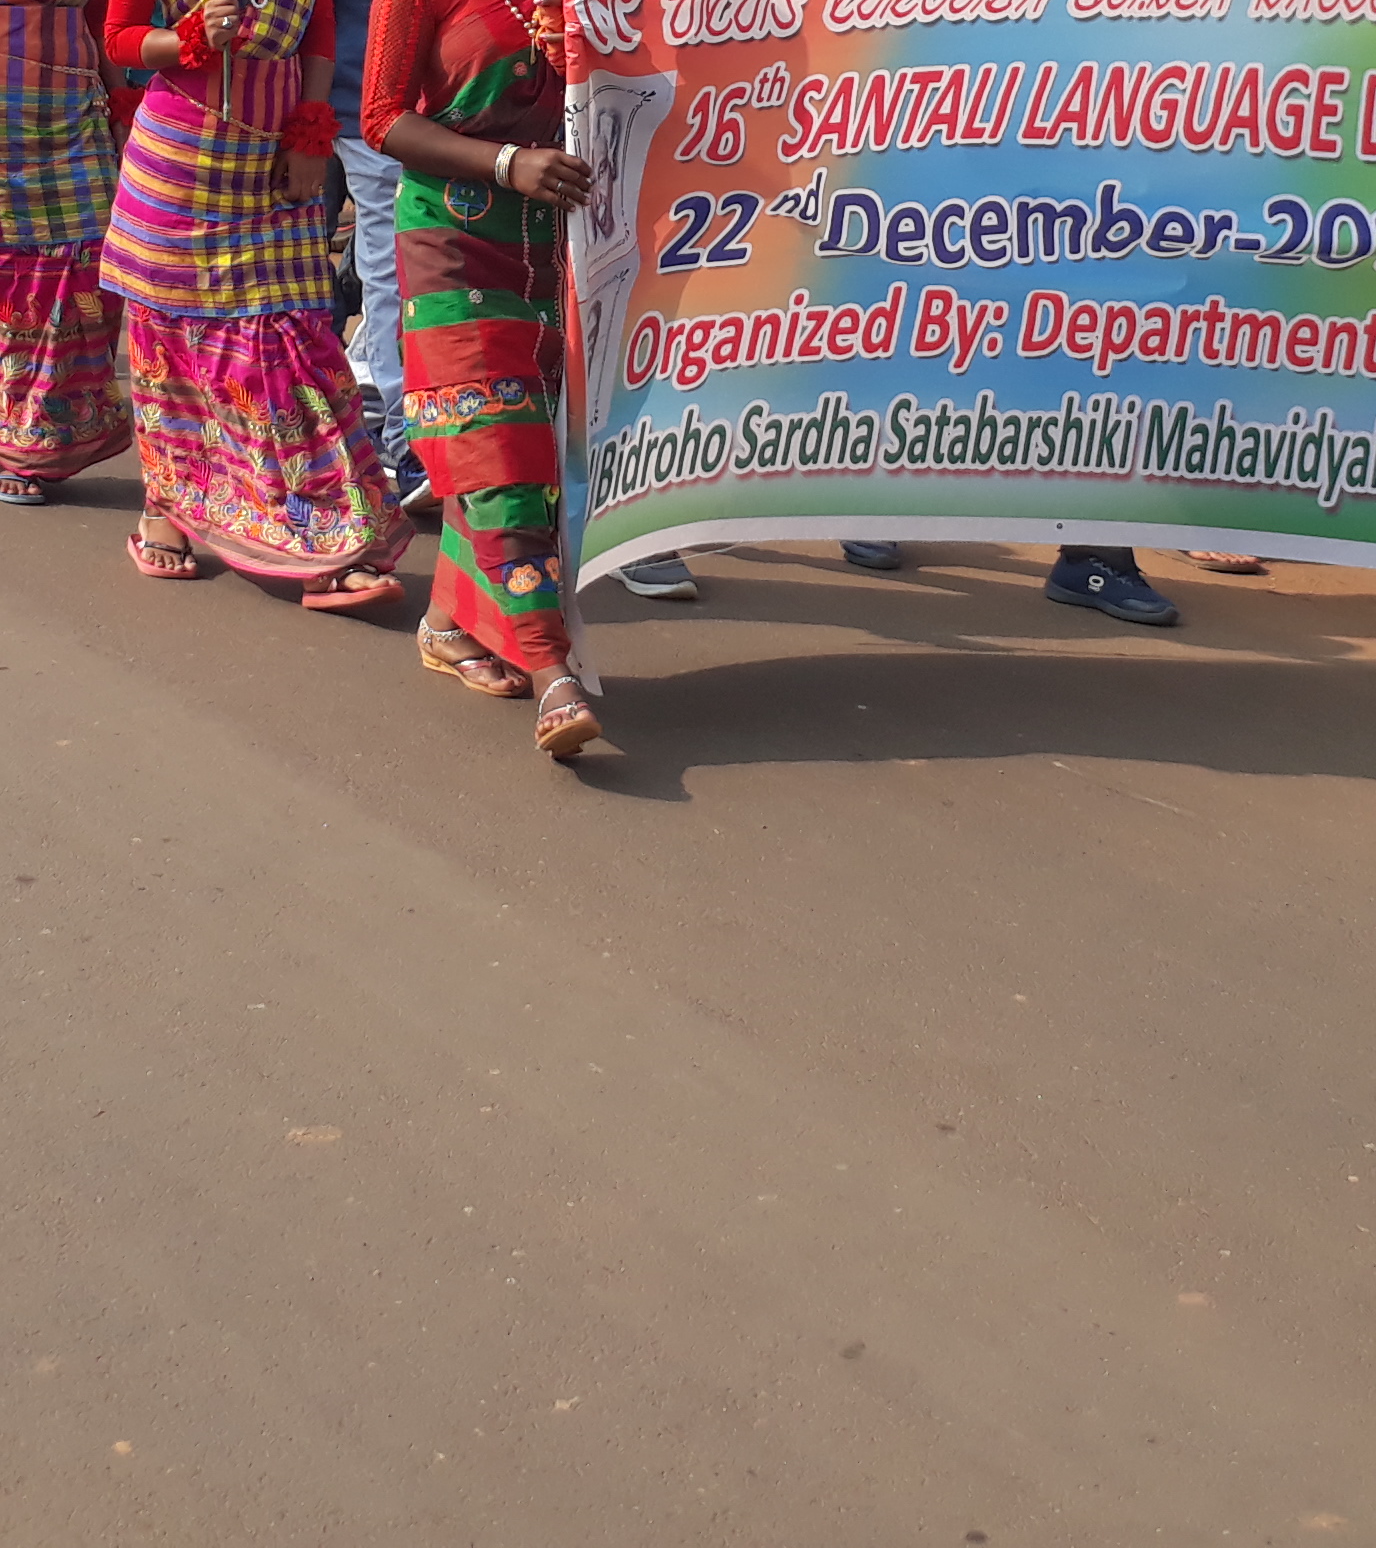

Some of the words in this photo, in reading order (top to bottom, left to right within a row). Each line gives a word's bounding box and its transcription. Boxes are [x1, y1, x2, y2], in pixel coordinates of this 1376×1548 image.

[778, 62, 1023, 162] SANTALI
[1019, 61, 1349, 157] LANGUAGE
[625, 281, 907, 390] Organized
[911, 284, 1009, 374] By:
[595, 403, 732, 516] Bidroho
[734, 391, 878, 472] Sardha
[882, 389, 1140, 475] Satabarshiki
